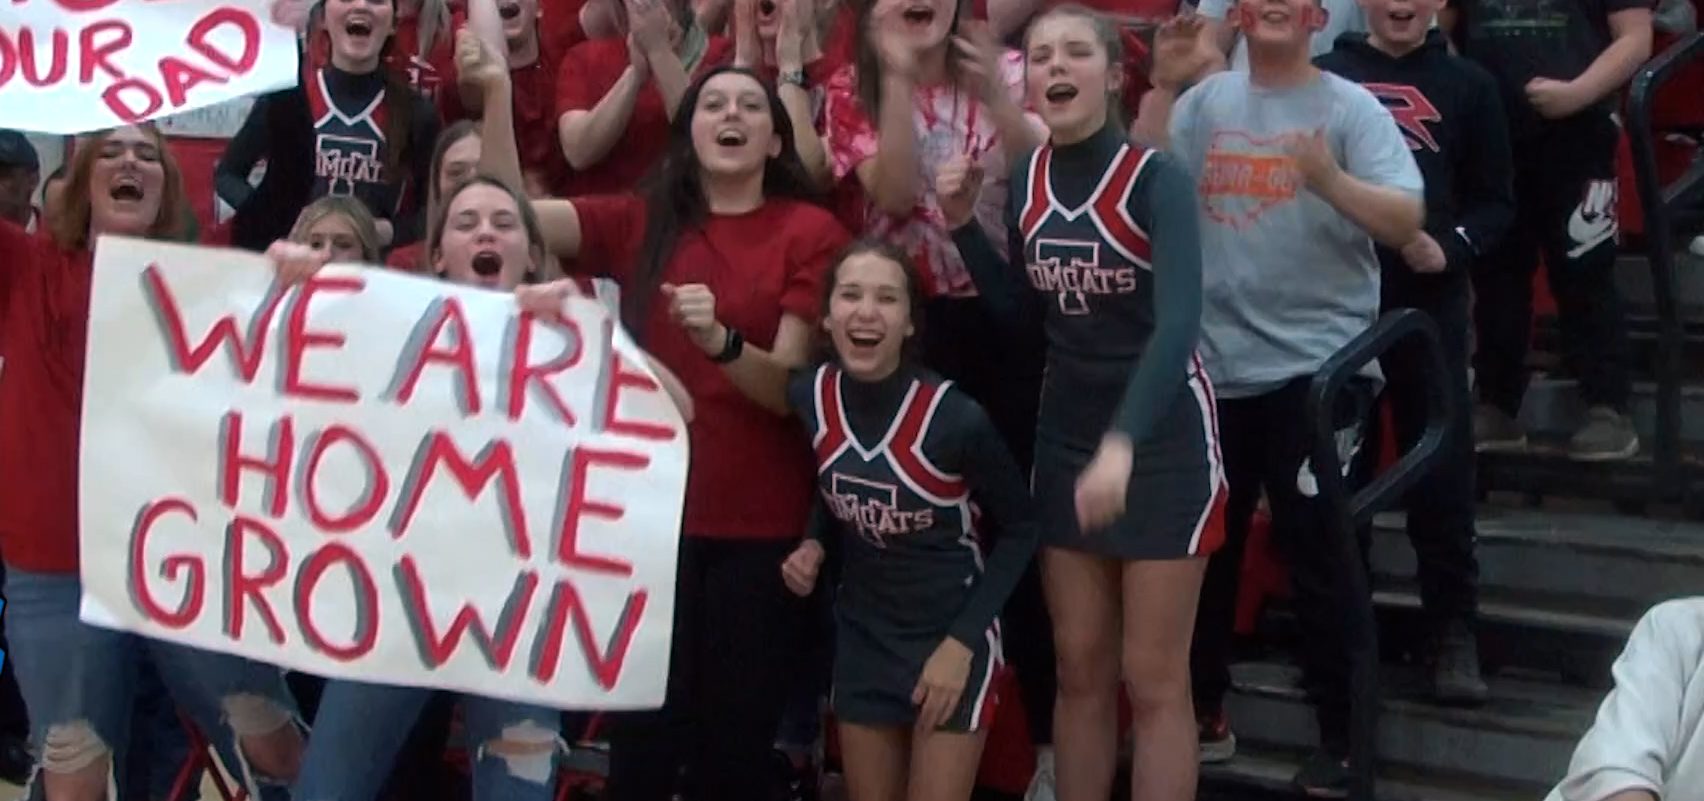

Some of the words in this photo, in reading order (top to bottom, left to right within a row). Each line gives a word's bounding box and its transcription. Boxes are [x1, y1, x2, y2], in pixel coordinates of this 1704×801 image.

[102, 7, 261, 123] DAD
[141, 261, 366, 402] WE
[382, 294, 677, 441] ARE
[217, 409, 652, 577] HOME
[128, 497, 650, 692] GROWN
